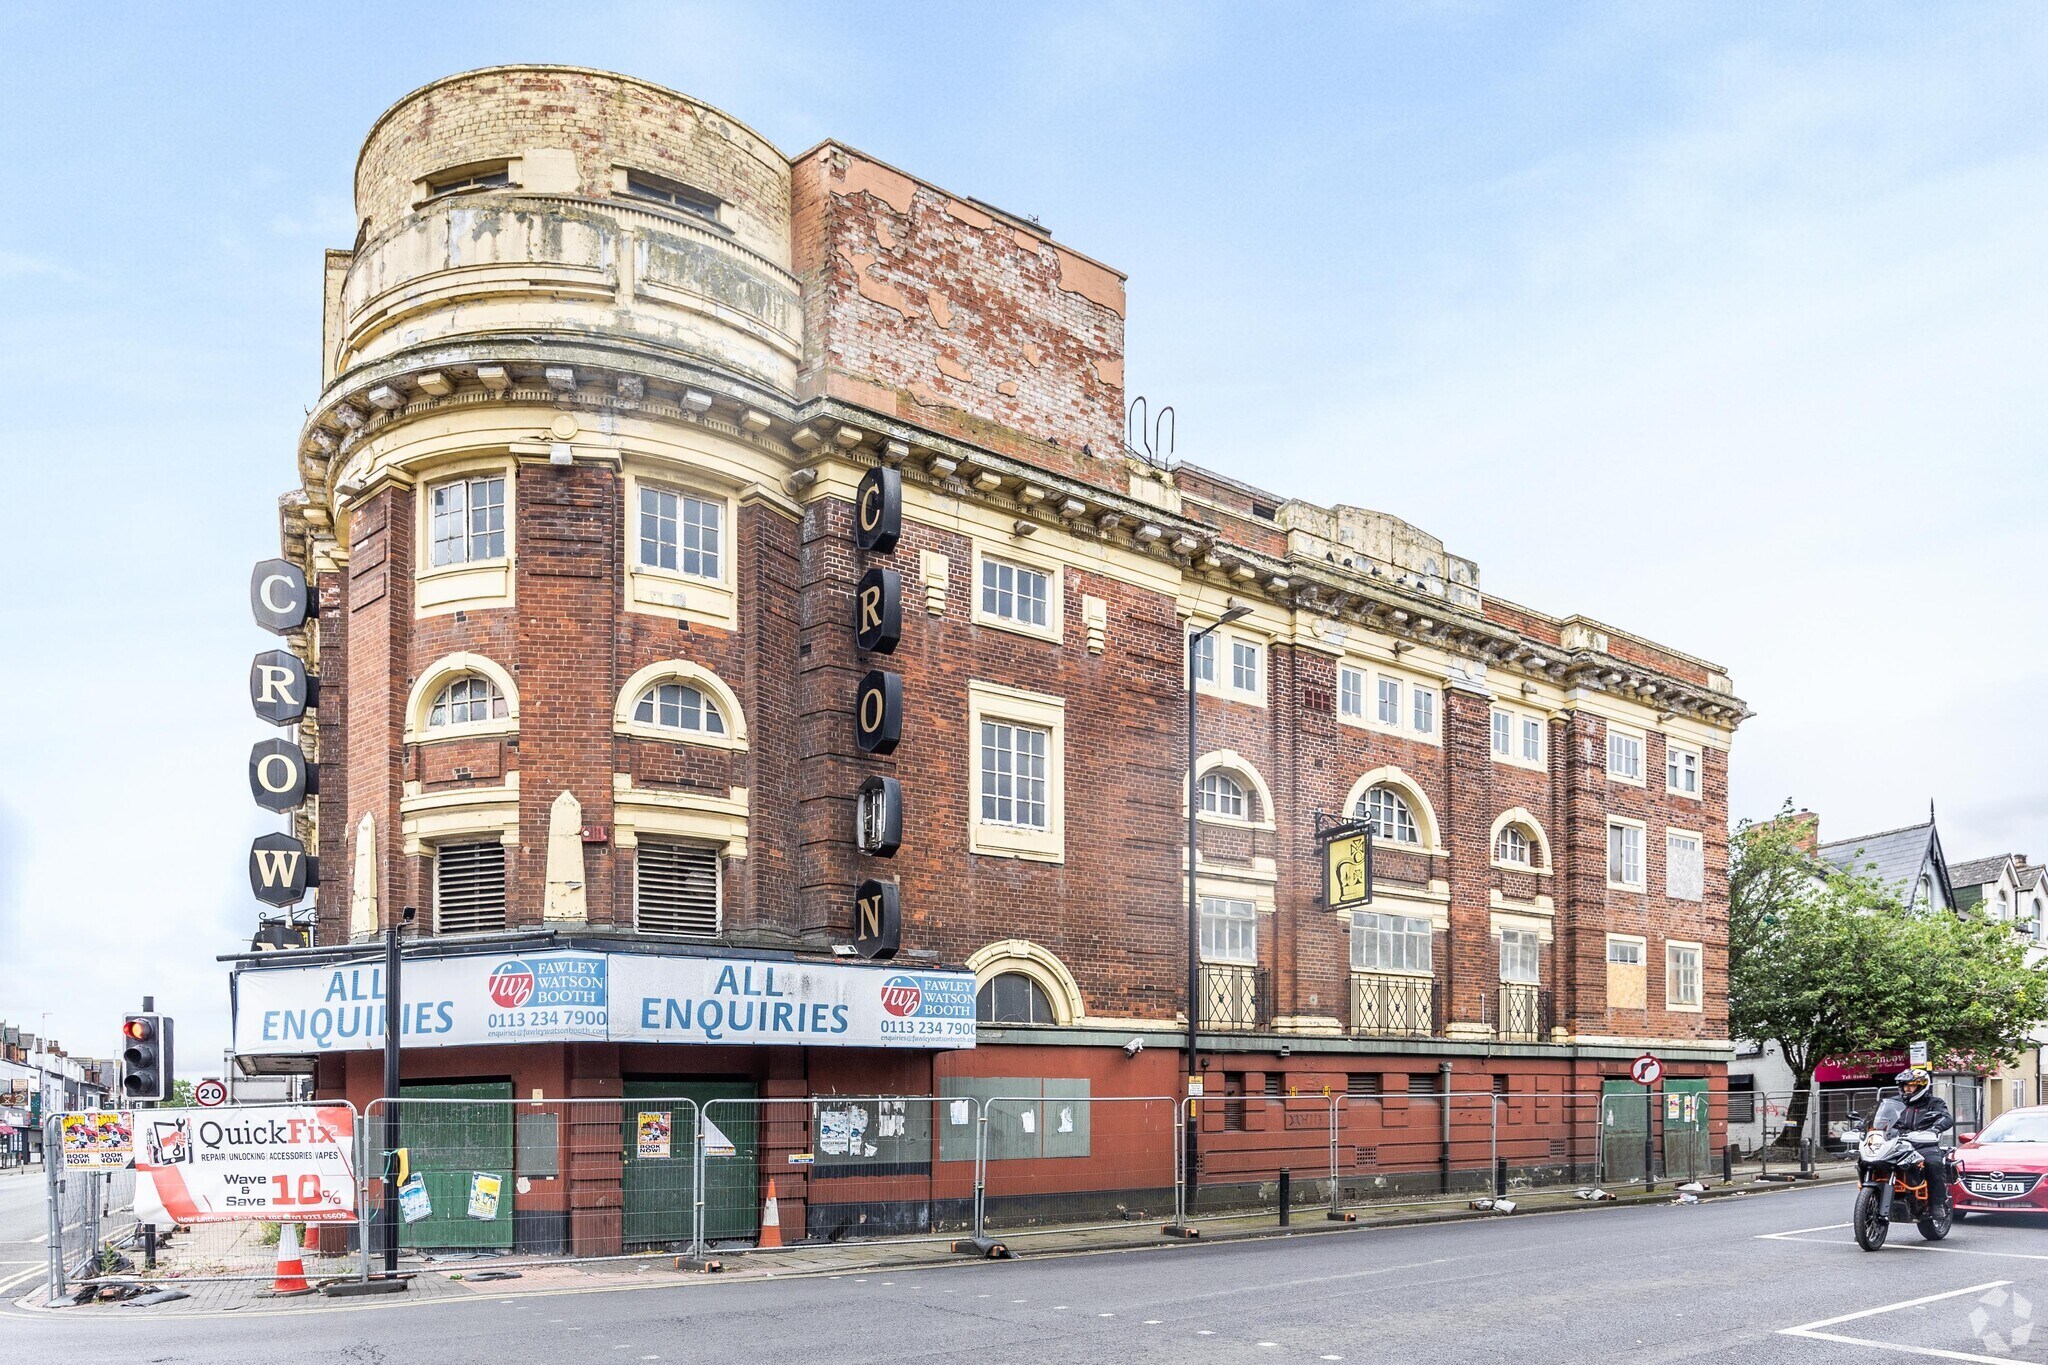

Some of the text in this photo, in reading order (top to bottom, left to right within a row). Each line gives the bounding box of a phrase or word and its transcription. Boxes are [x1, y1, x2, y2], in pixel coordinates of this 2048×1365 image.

[253, 573, 302, 951] CROW
[537, 961, 600, 975] FAWLEY
[324, 968, 386, 1003] ALL
[537, 975, 604, 989] WATSON
[713, 964, 784, 997] ALL
[924, 980, 973, 992] FAWLEY
[537, 990, 596, 1004] BOOTH
[924, 992, 976, 1005] WATSON
[924, 1004, 971, 1016] BOOTH
[488, 1010, 607, 1029] 0113 234 7900
[641, 997, 850, 1041] ENQUIRIES
[880, 1020, 915, 1034] 0113
[918, 1021, 943, 1035] 234
[200, 1088, 222, 1100] 20
[199, 1118, 337, 1150] QuickFix
[201, 1151, 339, 1162] REPAIR UNLOCKING ACCESSORIES VAPES
[223, 1174, 267, 1185] Wave
[241, 1185, 251, 1195] &
[271, 1173, 342, 1206] 10%
[1975, 1183, 2020, 1192] DE64 VBA
[225, 1196, 267, 1207] Save
